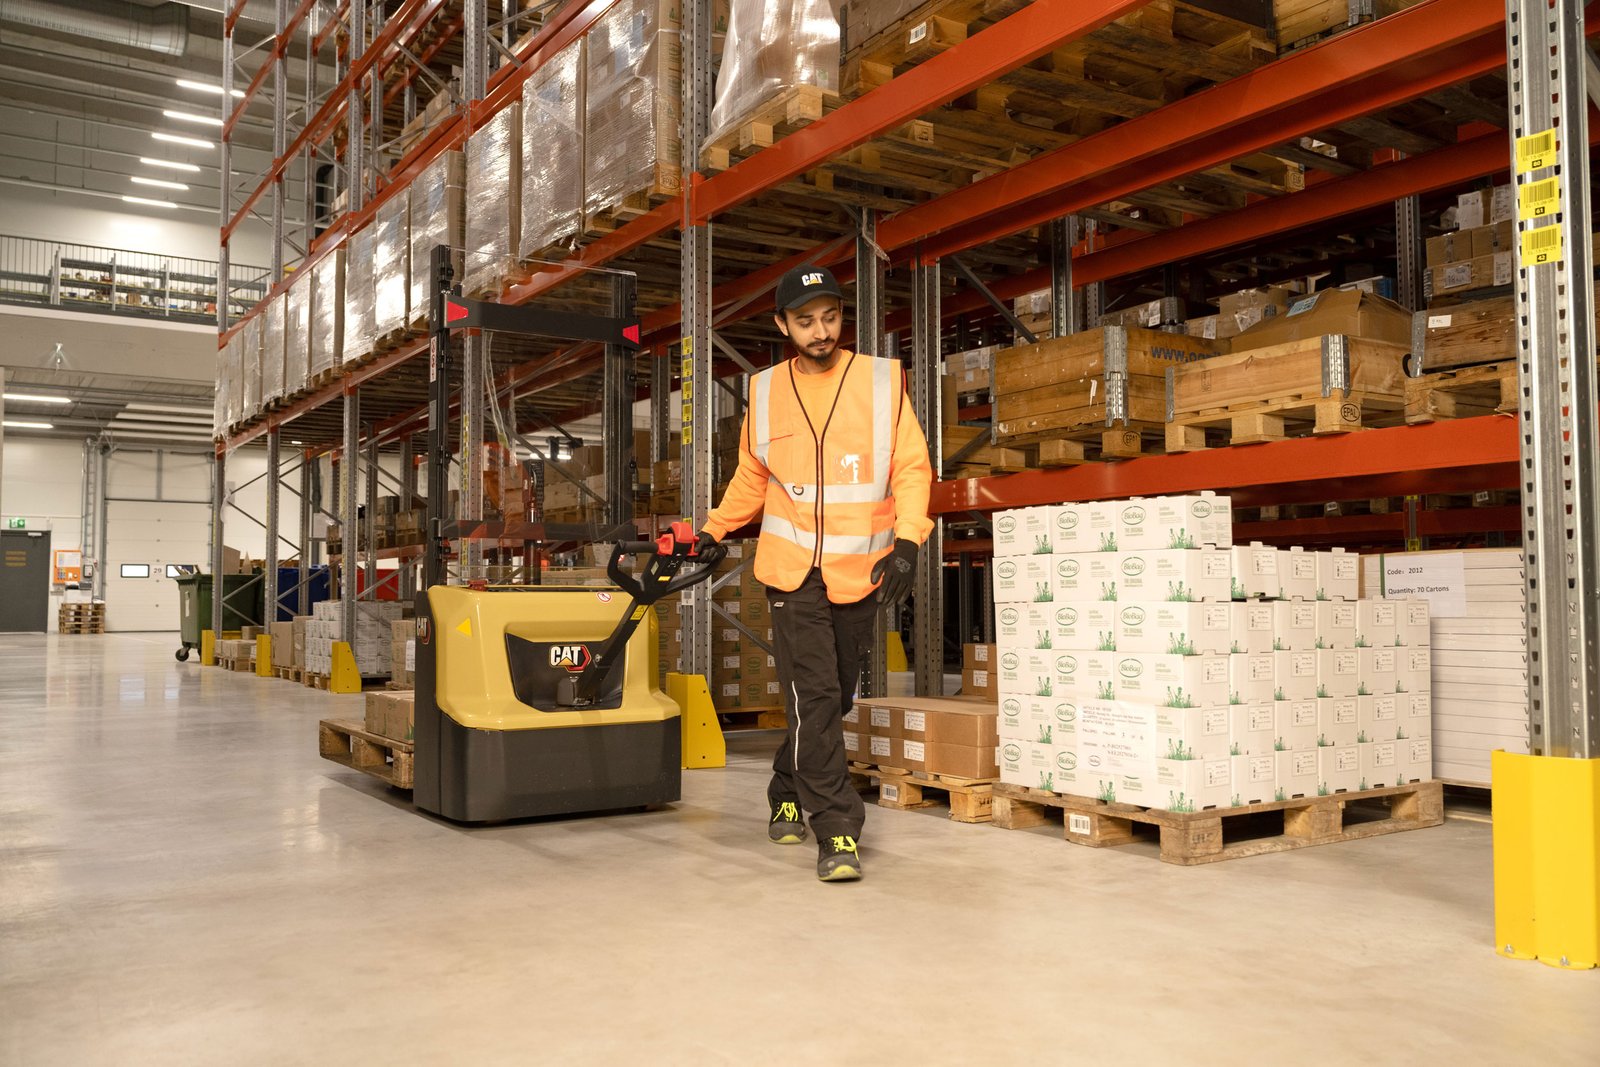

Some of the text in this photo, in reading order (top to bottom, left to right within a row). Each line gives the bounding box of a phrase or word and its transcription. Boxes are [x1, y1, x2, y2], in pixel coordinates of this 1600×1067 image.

[801, 272, 824, 286] CAT
[1388, 586, 1416, 595] Quantity:
[550, 646, 582, 667] CAT
